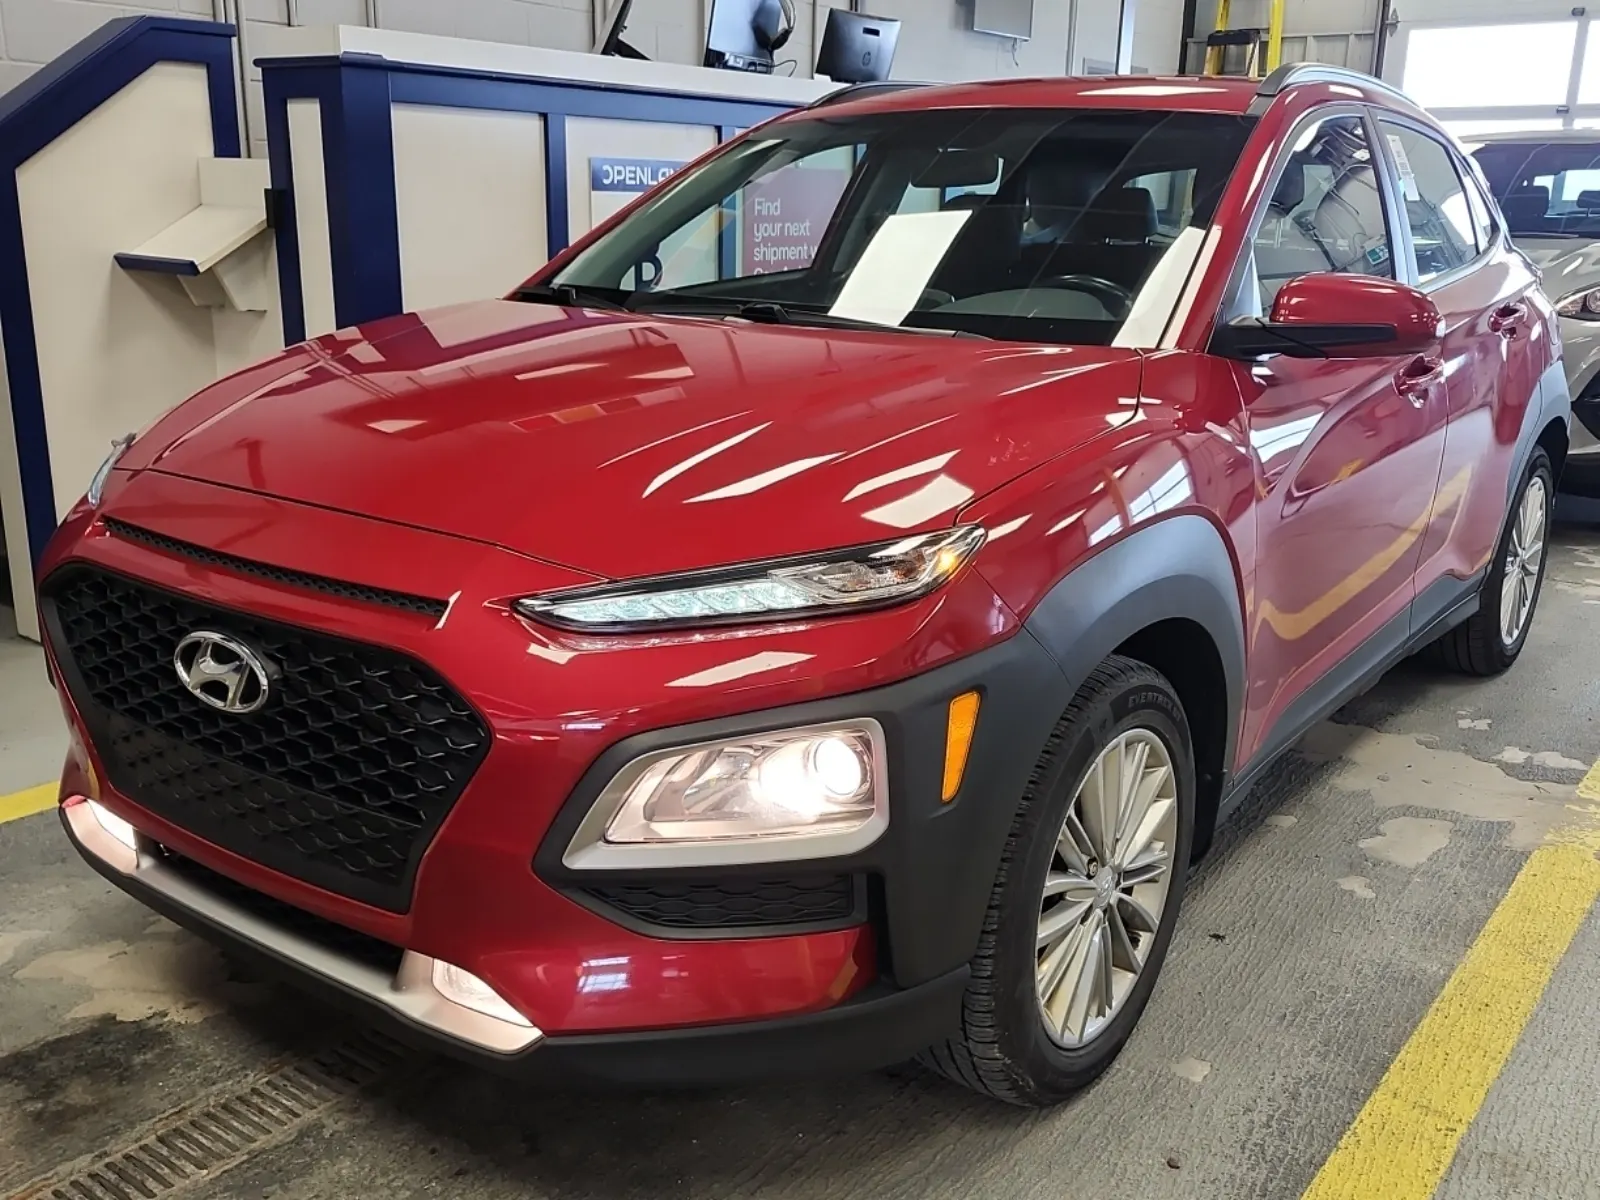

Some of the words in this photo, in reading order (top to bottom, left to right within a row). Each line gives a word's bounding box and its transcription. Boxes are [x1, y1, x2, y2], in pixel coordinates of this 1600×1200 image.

[602, 164, 678, 185] OPENLA
[754, 198, 781, 216] Find
[753, 223, 782, 242] your
[784, 219, 811, 237] next
[753, 242, 808, 265] shipment
